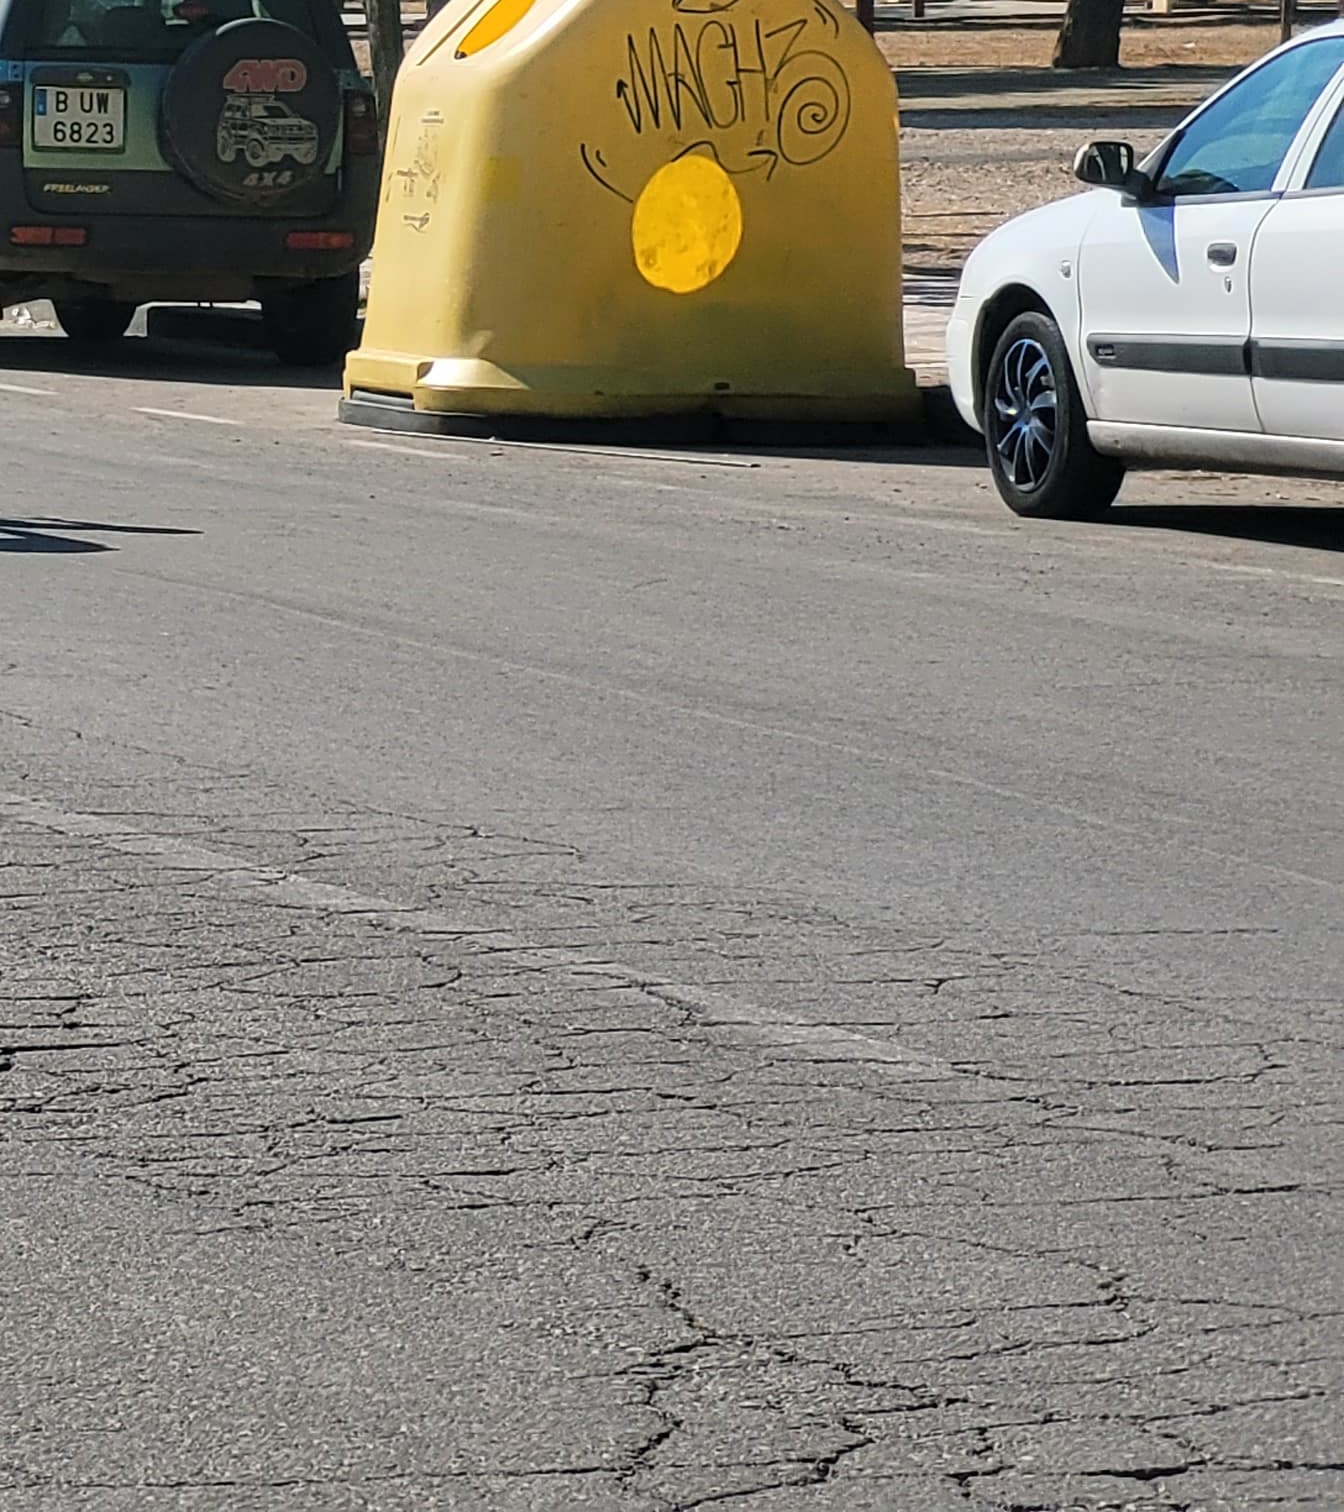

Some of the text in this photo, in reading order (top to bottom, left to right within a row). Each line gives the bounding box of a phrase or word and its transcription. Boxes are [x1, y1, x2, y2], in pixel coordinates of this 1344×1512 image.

[223, 59, 307, 93] 4WD
[55, 91, 109, 114] B UW
[53, 121, 114, 144] 6823
